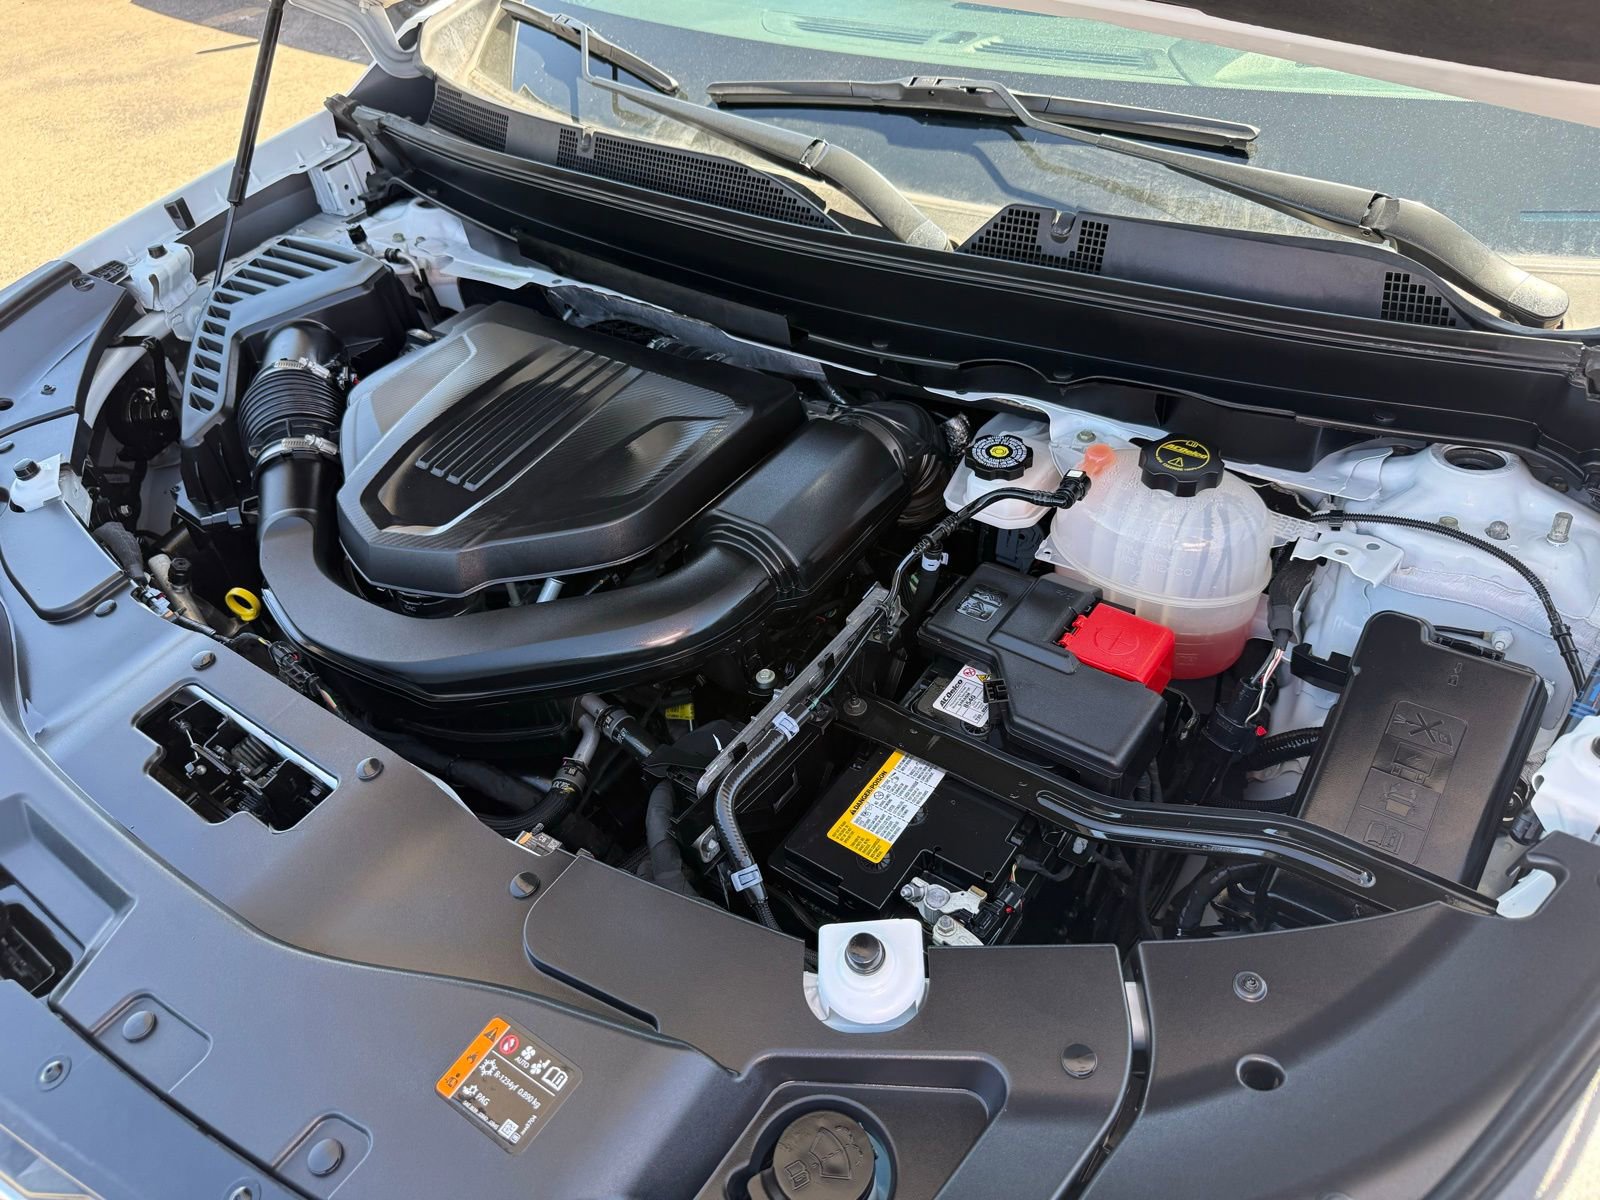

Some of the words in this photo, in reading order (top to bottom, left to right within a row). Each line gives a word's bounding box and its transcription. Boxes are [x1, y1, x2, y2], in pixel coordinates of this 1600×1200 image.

[1161, 444, 1208, 460] ACDelco
[939, 679, 963, 707] ACDelco
[514, 1056, 530, 1069] AUTO
[493, 1070, 519, 1092] R-1234yf
[517, 1088, 534, 1103] 0.890
[532, 1097, 541, 1109] kg
[475, 1092, 491, 1107] PAG
